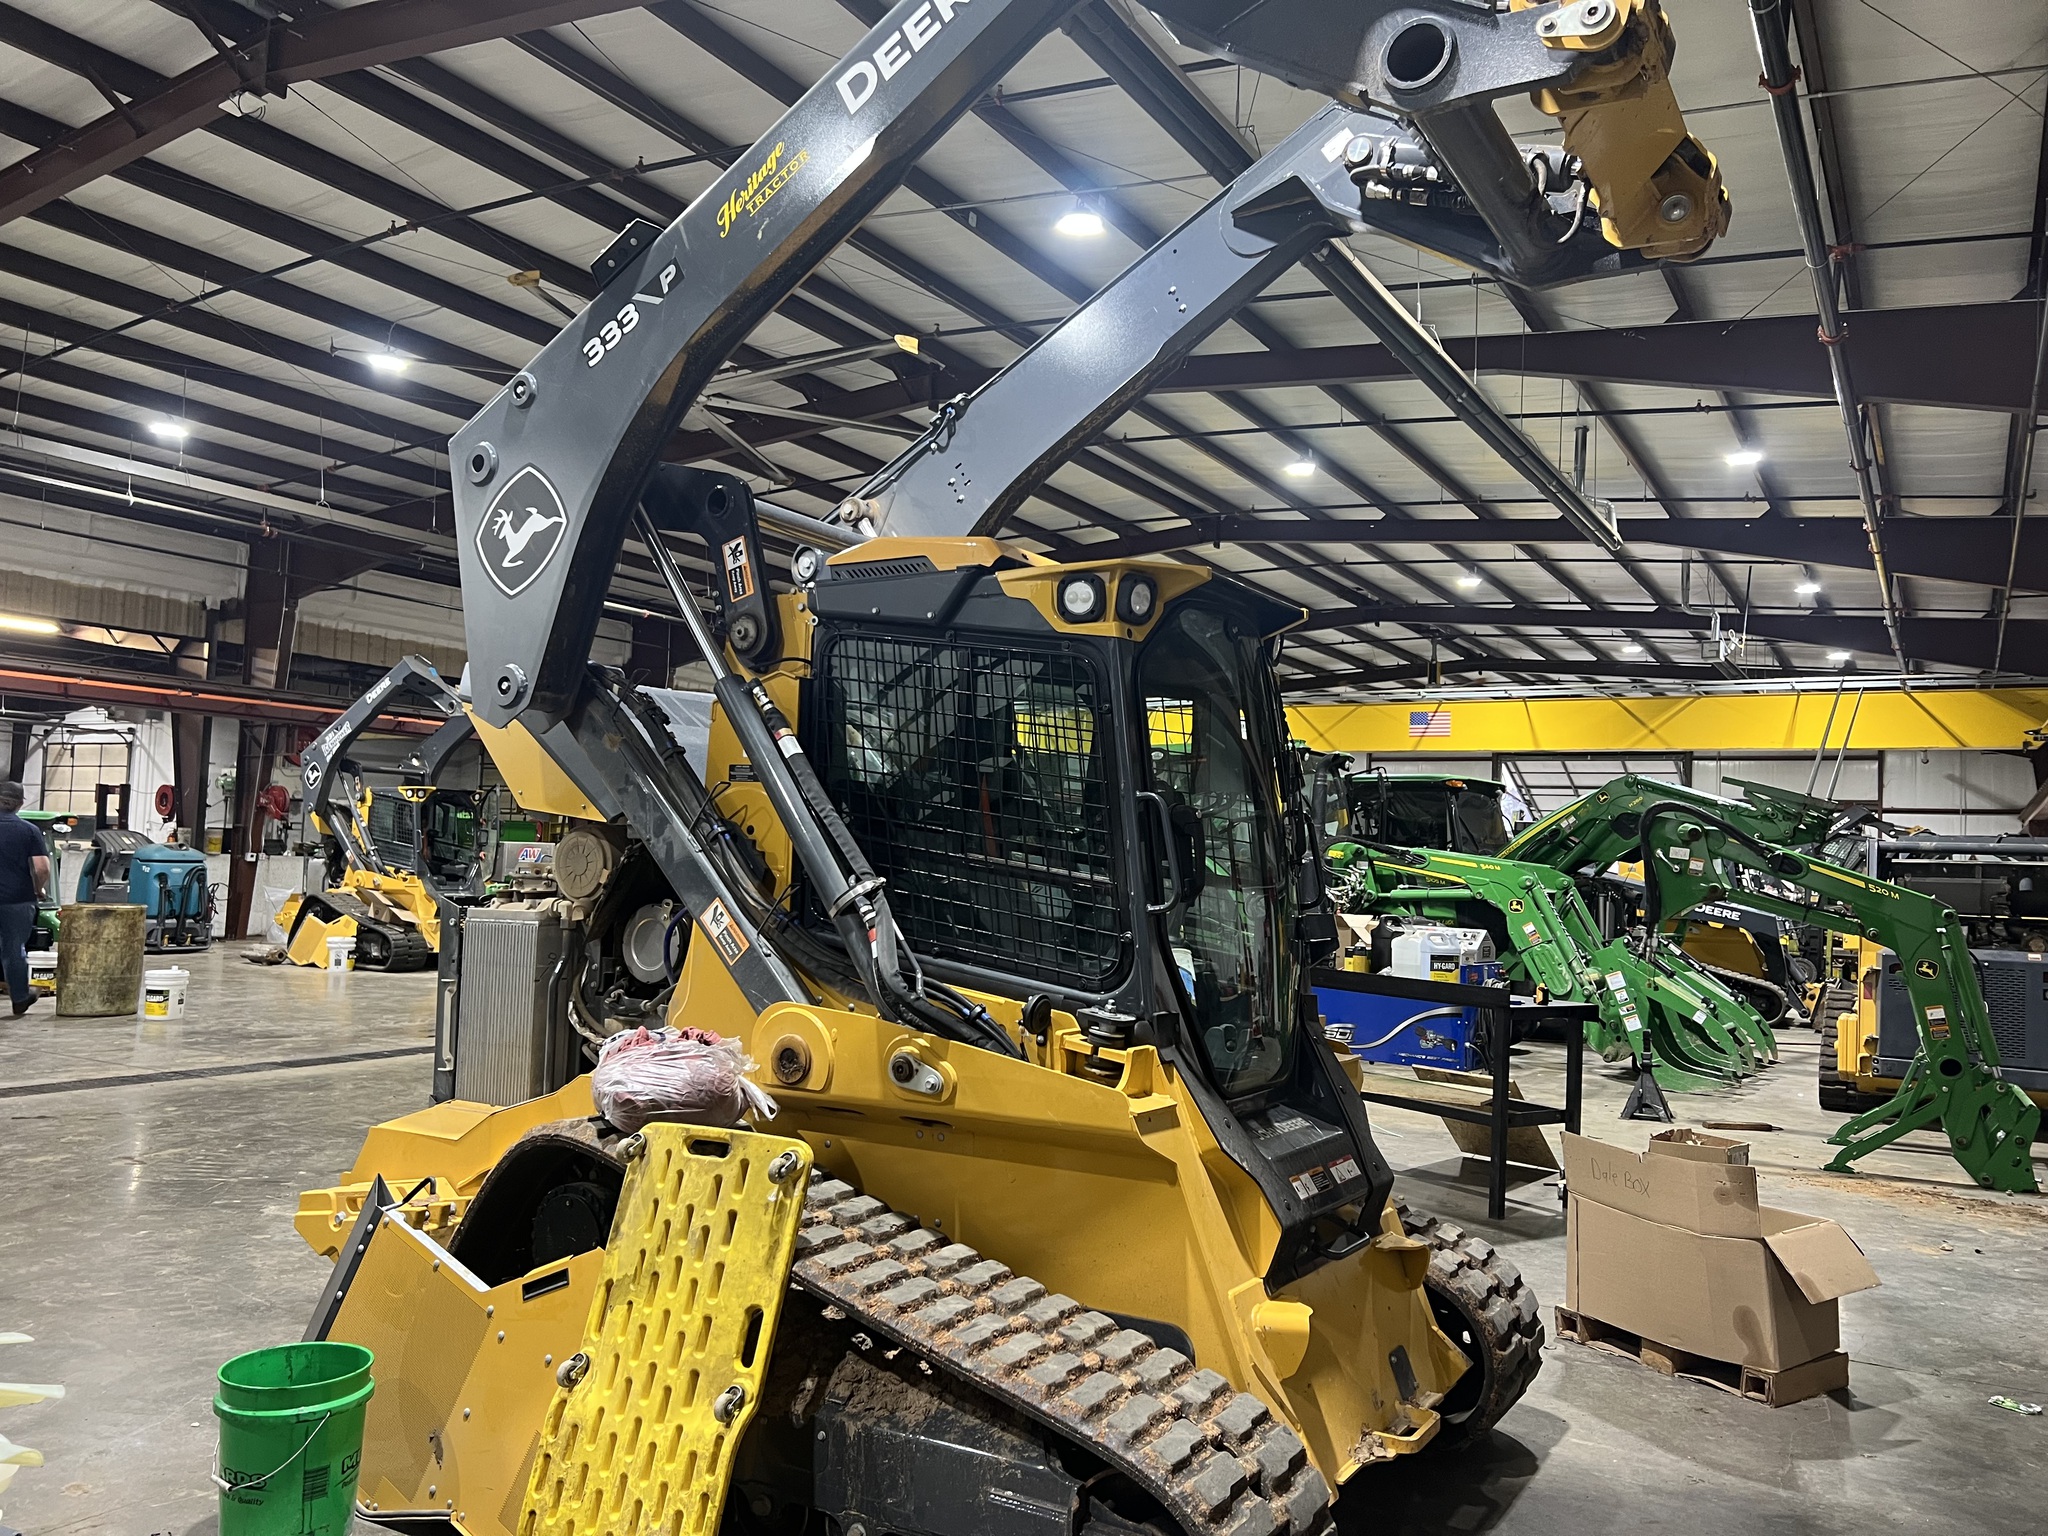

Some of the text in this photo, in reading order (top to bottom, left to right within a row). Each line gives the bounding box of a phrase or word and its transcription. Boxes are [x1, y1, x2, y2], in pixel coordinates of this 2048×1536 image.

[716, 141, 785, 239] Heritage
[746, 148, 811, 215] TRACTOR
[582, 302, 641, 368] 333
[1433, 962, 1456, 970] HY-GARD
[1273, 1117, 1312, 1135] DEERE
[237, 1496, 264, 1507] Quality
